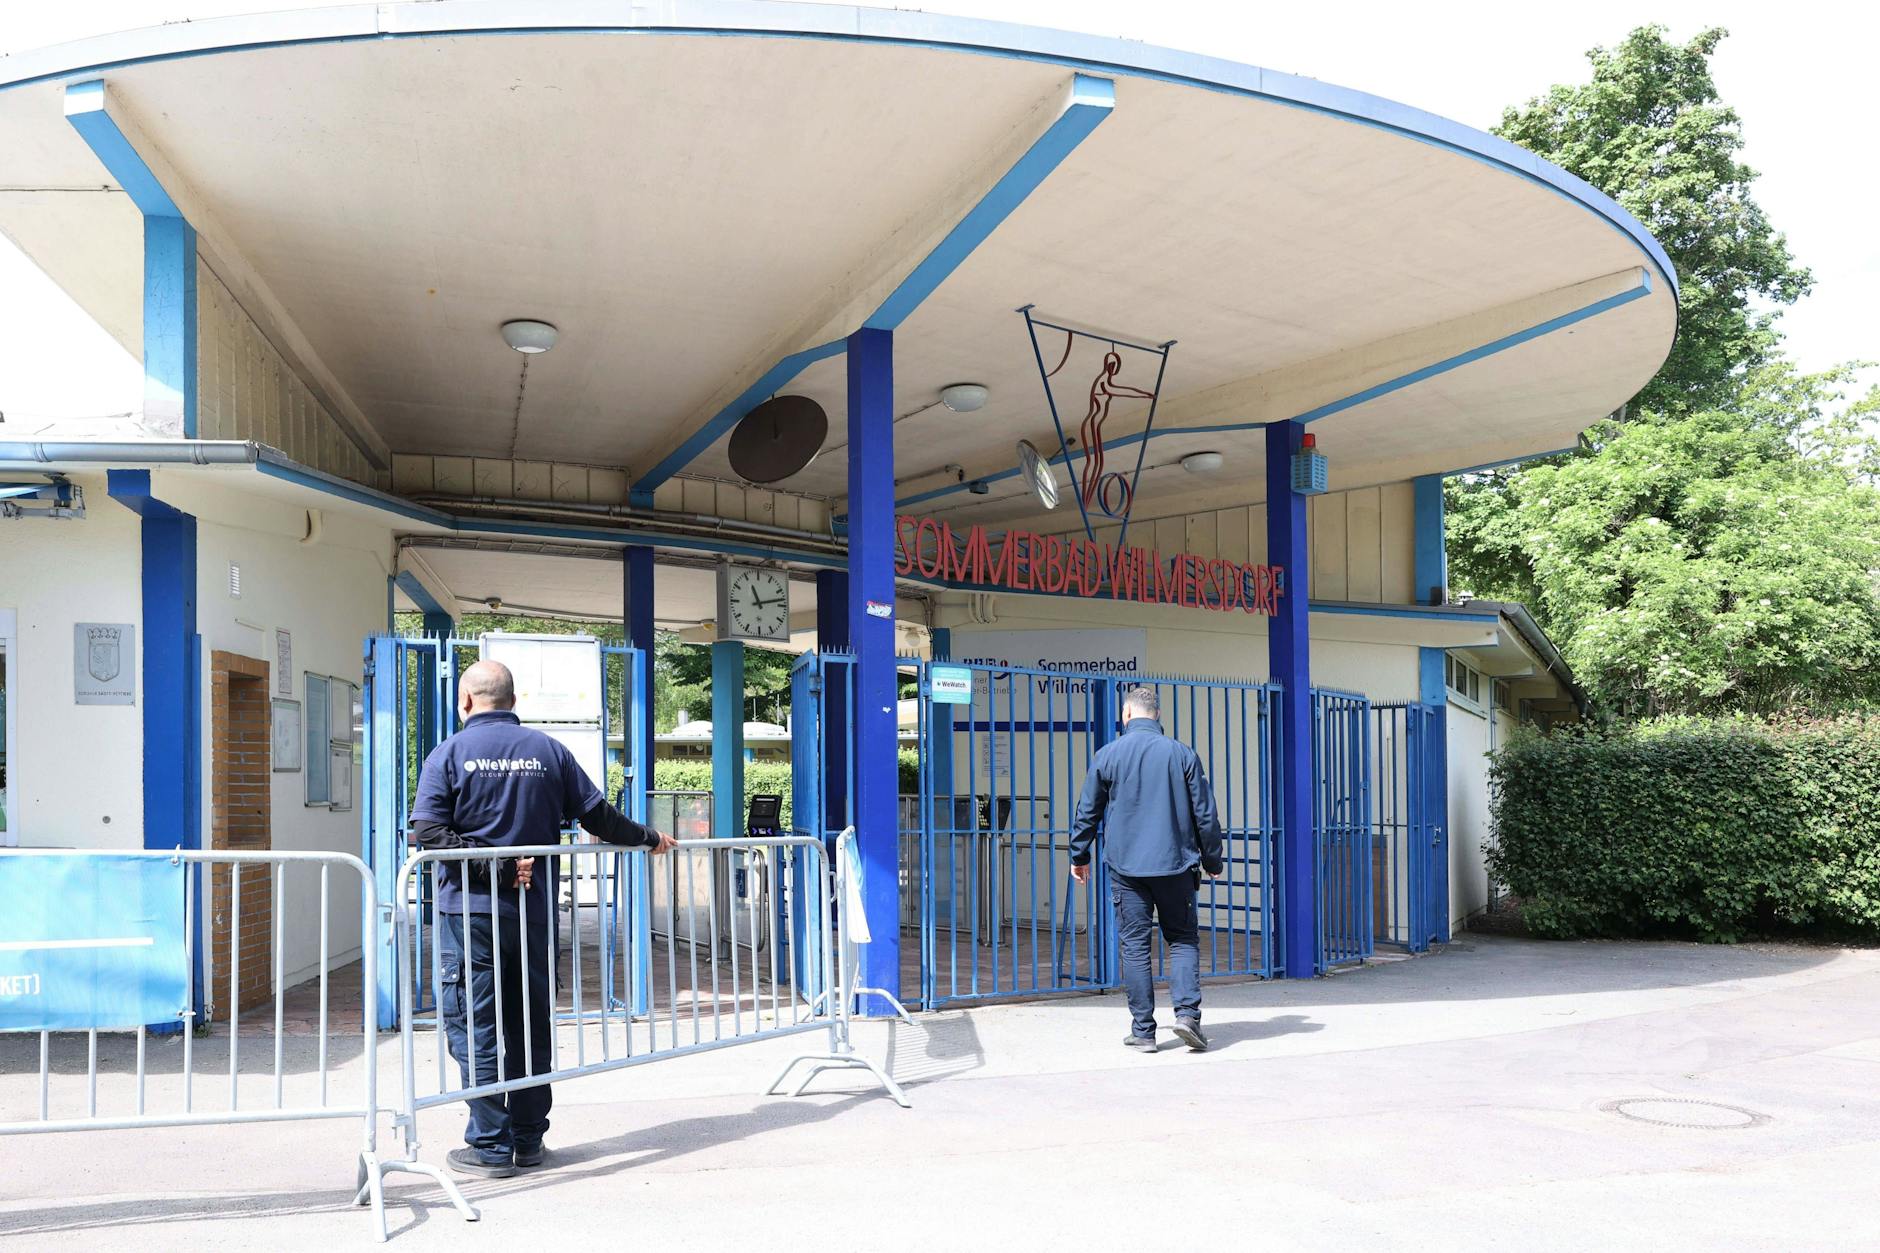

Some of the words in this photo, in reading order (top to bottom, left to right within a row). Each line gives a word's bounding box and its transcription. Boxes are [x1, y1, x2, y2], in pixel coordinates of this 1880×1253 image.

[895, 514, 1102, 597] SOMMERBAD
[1106, 544, 1284, 617] WILMERSDORF
[1038, 656, 1137, 672] Sommerbad
